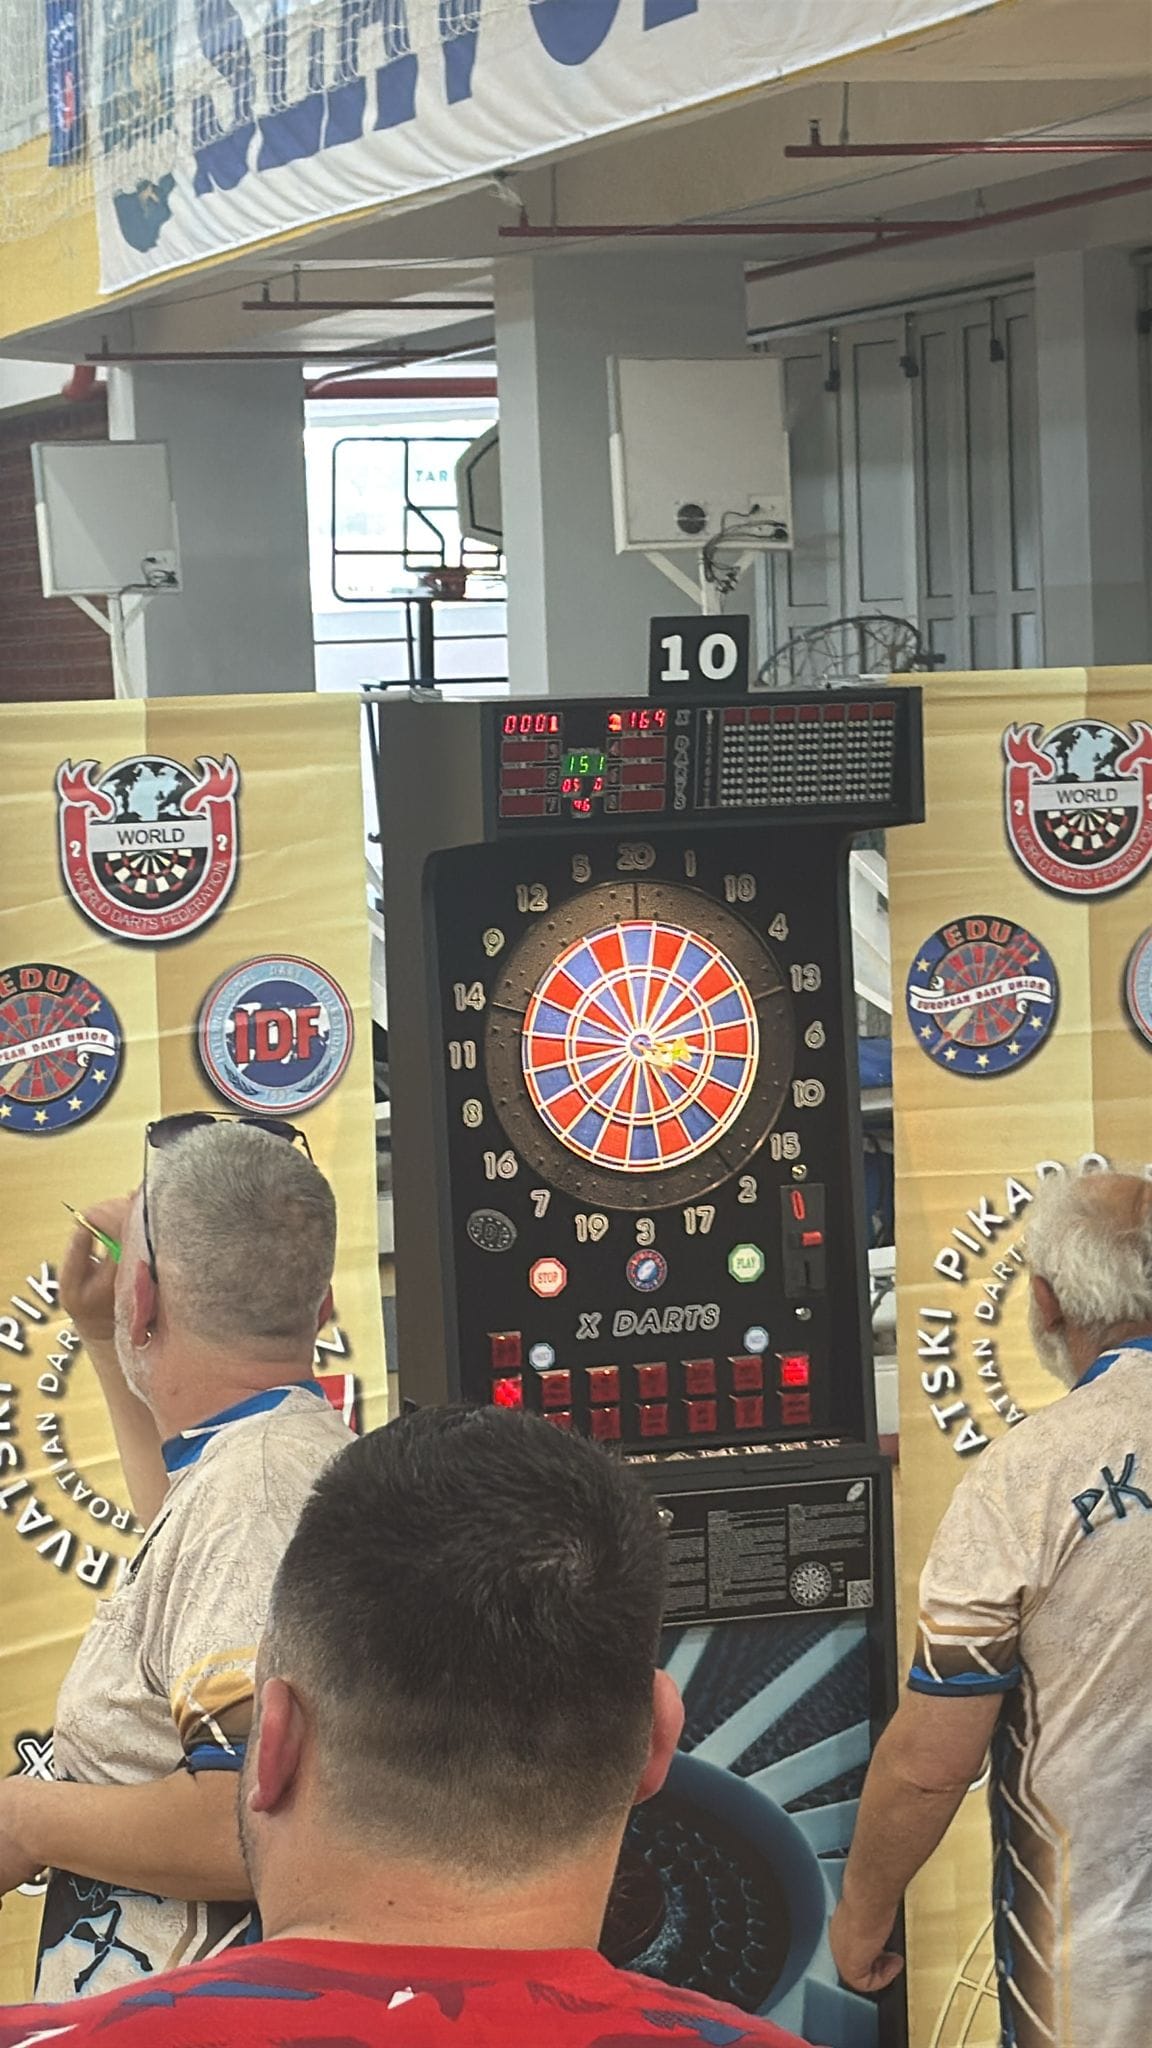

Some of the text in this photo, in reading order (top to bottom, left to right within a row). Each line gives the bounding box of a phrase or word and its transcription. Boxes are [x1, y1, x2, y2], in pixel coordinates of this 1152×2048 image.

[660, 633, 738, 682] 10
[1056, 788, 1119, 804] WORLD
[117, 828, 185, 845] WORLD
[616, 843, 656, 871] 20
[684, 848, 697, 877] 1
[74, 859, 228, 931] WORLD DARTS FEDERATION
[515, 884, 549, 913] 12
[724, 873, 757, 902] 18
[483, 927, 505, 957] 9
[767, 913, 789, 942] 4
[942, 919, 1011, 948] EDU
[790, 963, 822, 992] 13
[454, 982, 486, 1012] 14
[916, 980, 1046, 1011] EUROPEAN DART UNION
[0, 1031, 109, 1062] EAN DART UNION
[234, 1005, 322, 1065] IDF
[804, 1020, 826, 1049] 6
[449, 1040, 477, 1070] 11
[793, 1079, 826, 1108] 10
[462, 1098, 484, 1129] 8
[770, 1131, 801, 1159] 15
[484, 1151, 519, 1180] 16
[531, 1188, 551, 1218] 7
[737, 1176, 758, 1204] 2
[575, 1213, 609, 1242] 19
[635, 1217, 656, 1246] 3
[683, 1205, 716, 1234] 17
[536, 1271, 558, 1285] STOP
[576, 1303, 721, 1340] X DARTS
